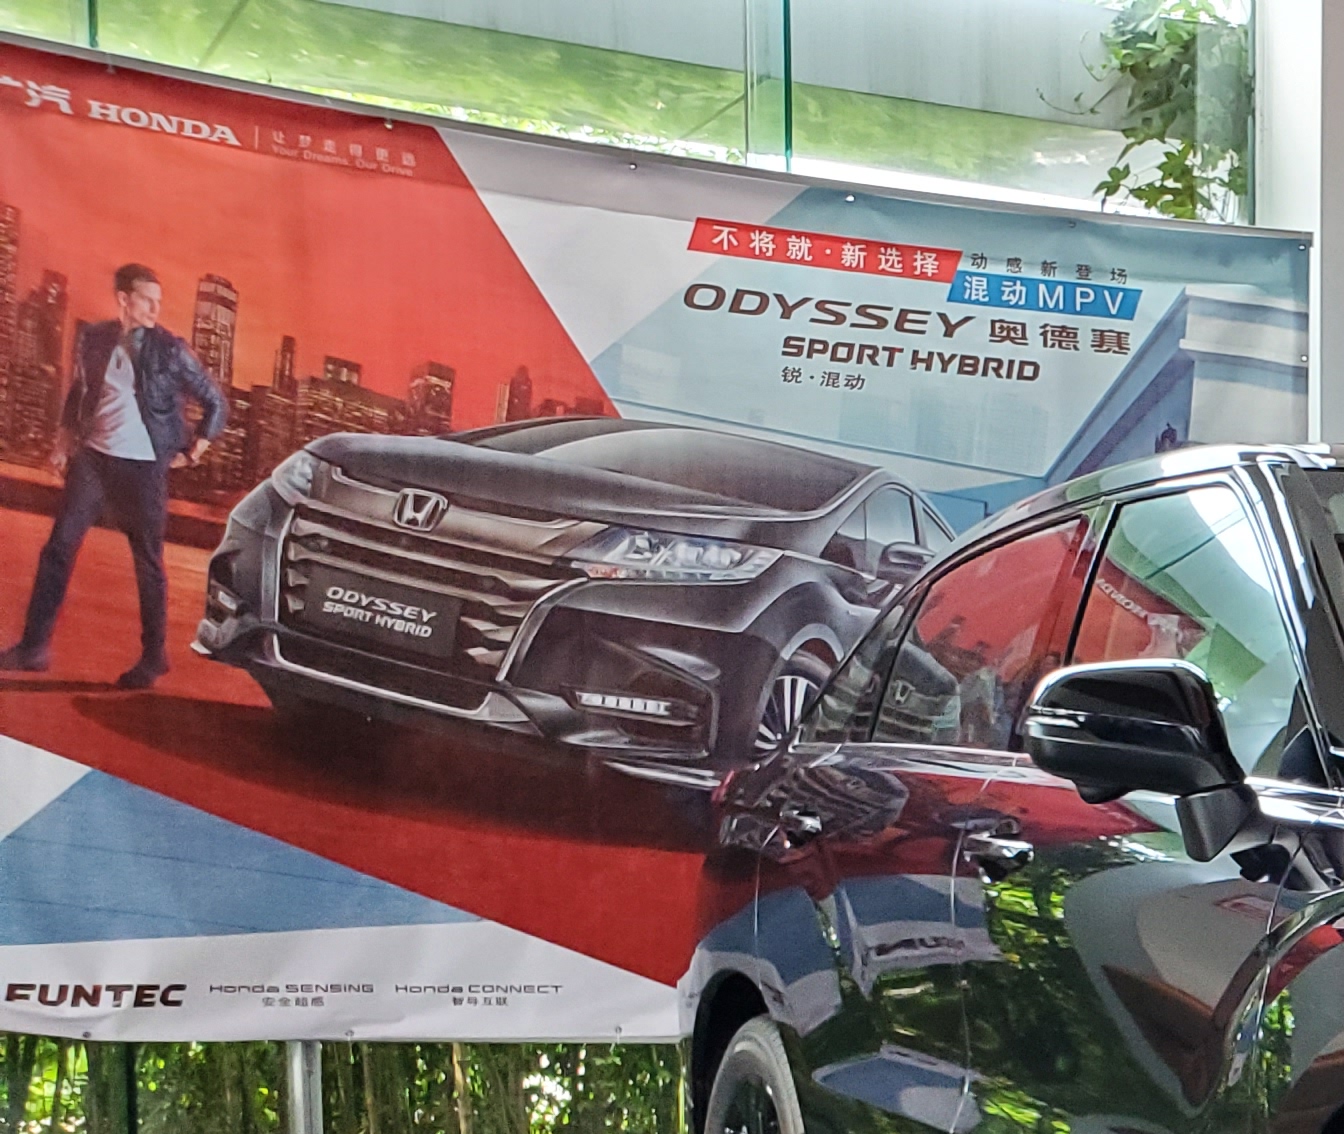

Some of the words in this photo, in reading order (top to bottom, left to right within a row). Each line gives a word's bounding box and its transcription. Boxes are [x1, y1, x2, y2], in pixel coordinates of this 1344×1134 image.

[88, 100, 241, 146] HONDA
[271, 144, 298, 157] Your
[355, 158, 378, 170] Our
[970, 252, 1128, 285] 动感新登场
[963, 275, 1124, 315] 混动MPV
[684, 283, 976, 338] ODYSSEY
[989, 318, 1131, 355] 奥德赛
[781, 335, 904, 368] SPORT
[910, 350, 1041, 381] HYBRID
[322, 601, 373, 622] SPORT
[374, 614, 433, 638] HYBRID
[326, 586, 438, 623] ODYSSEY
[5, 984, 188, 1007] FUNTEC
[209, 984, 280, 993] Honda
[285, 984, 374, 993] SENSING
[395, 984, 463, 994] Honda
[468, 985, 563, 994] CONNECT
